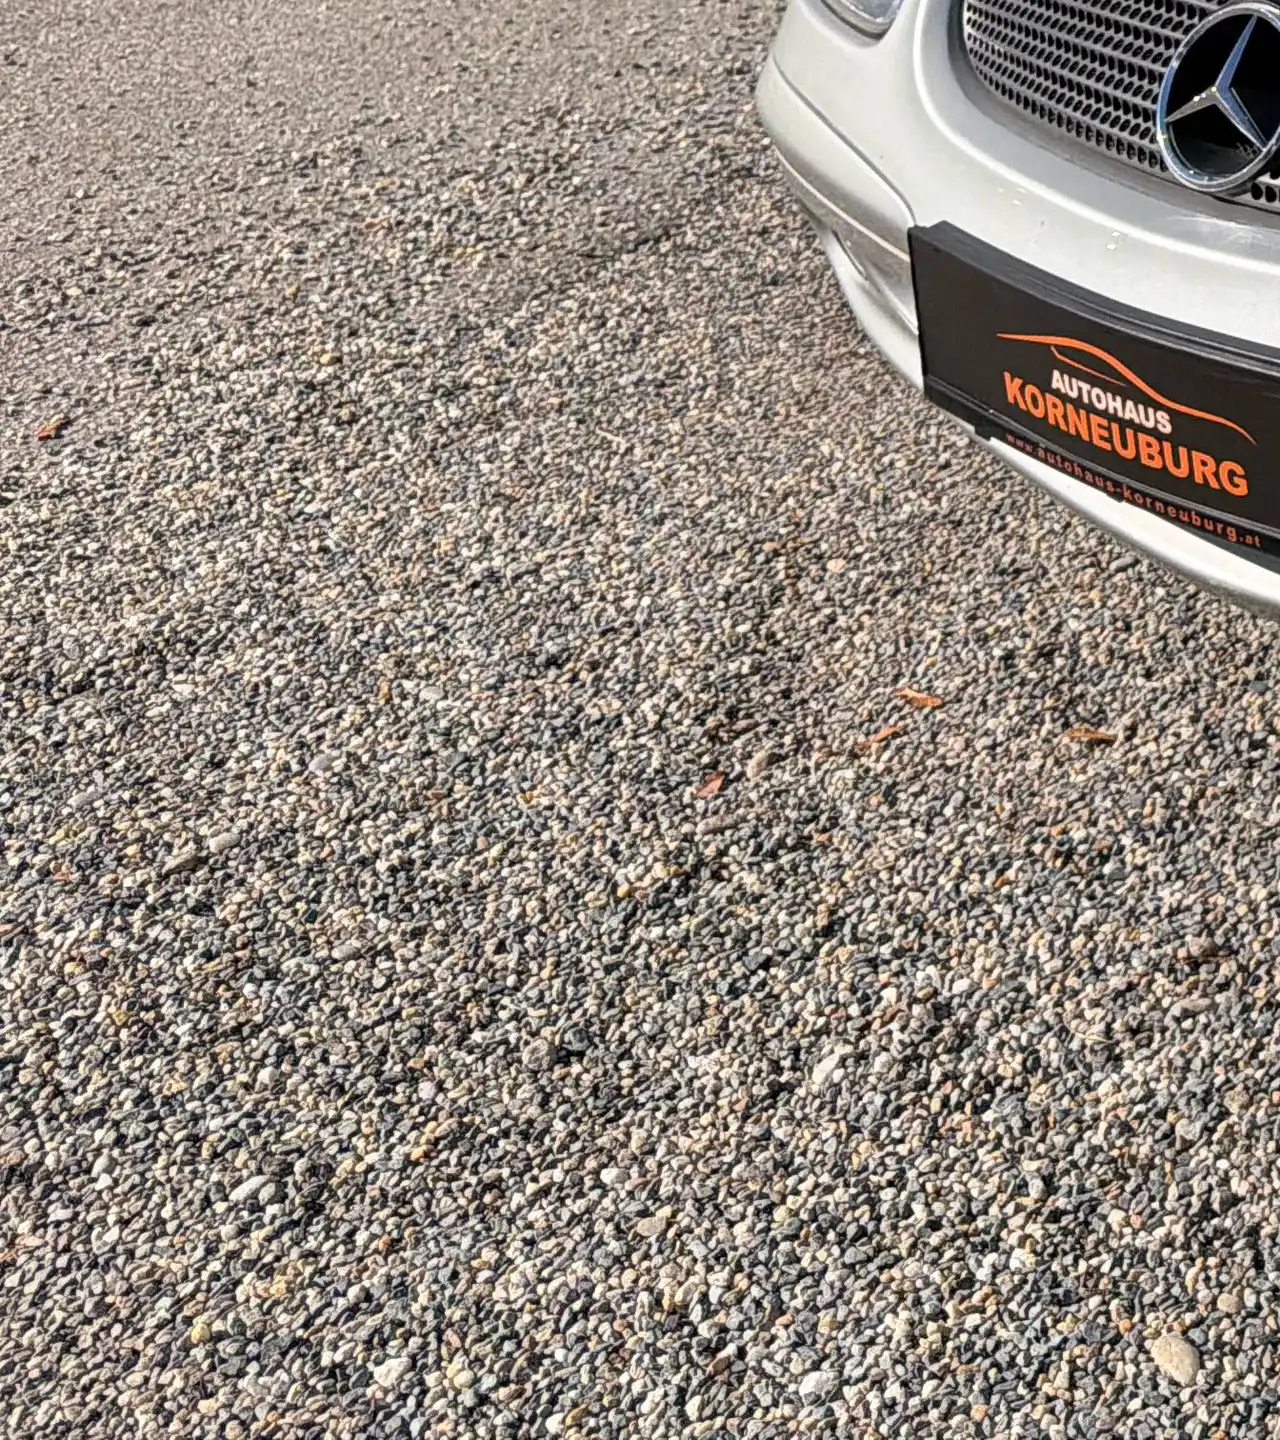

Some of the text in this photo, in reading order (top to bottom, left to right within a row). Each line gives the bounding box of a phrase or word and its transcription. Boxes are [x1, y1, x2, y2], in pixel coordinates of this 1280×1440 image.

[1003, 371, 1249, 497] KORNEUBURG
[1051, 369, 1173, 435] AUTOHAUS
[1006, 433, 1262, 548] www.autohaus-korneuburg.at
